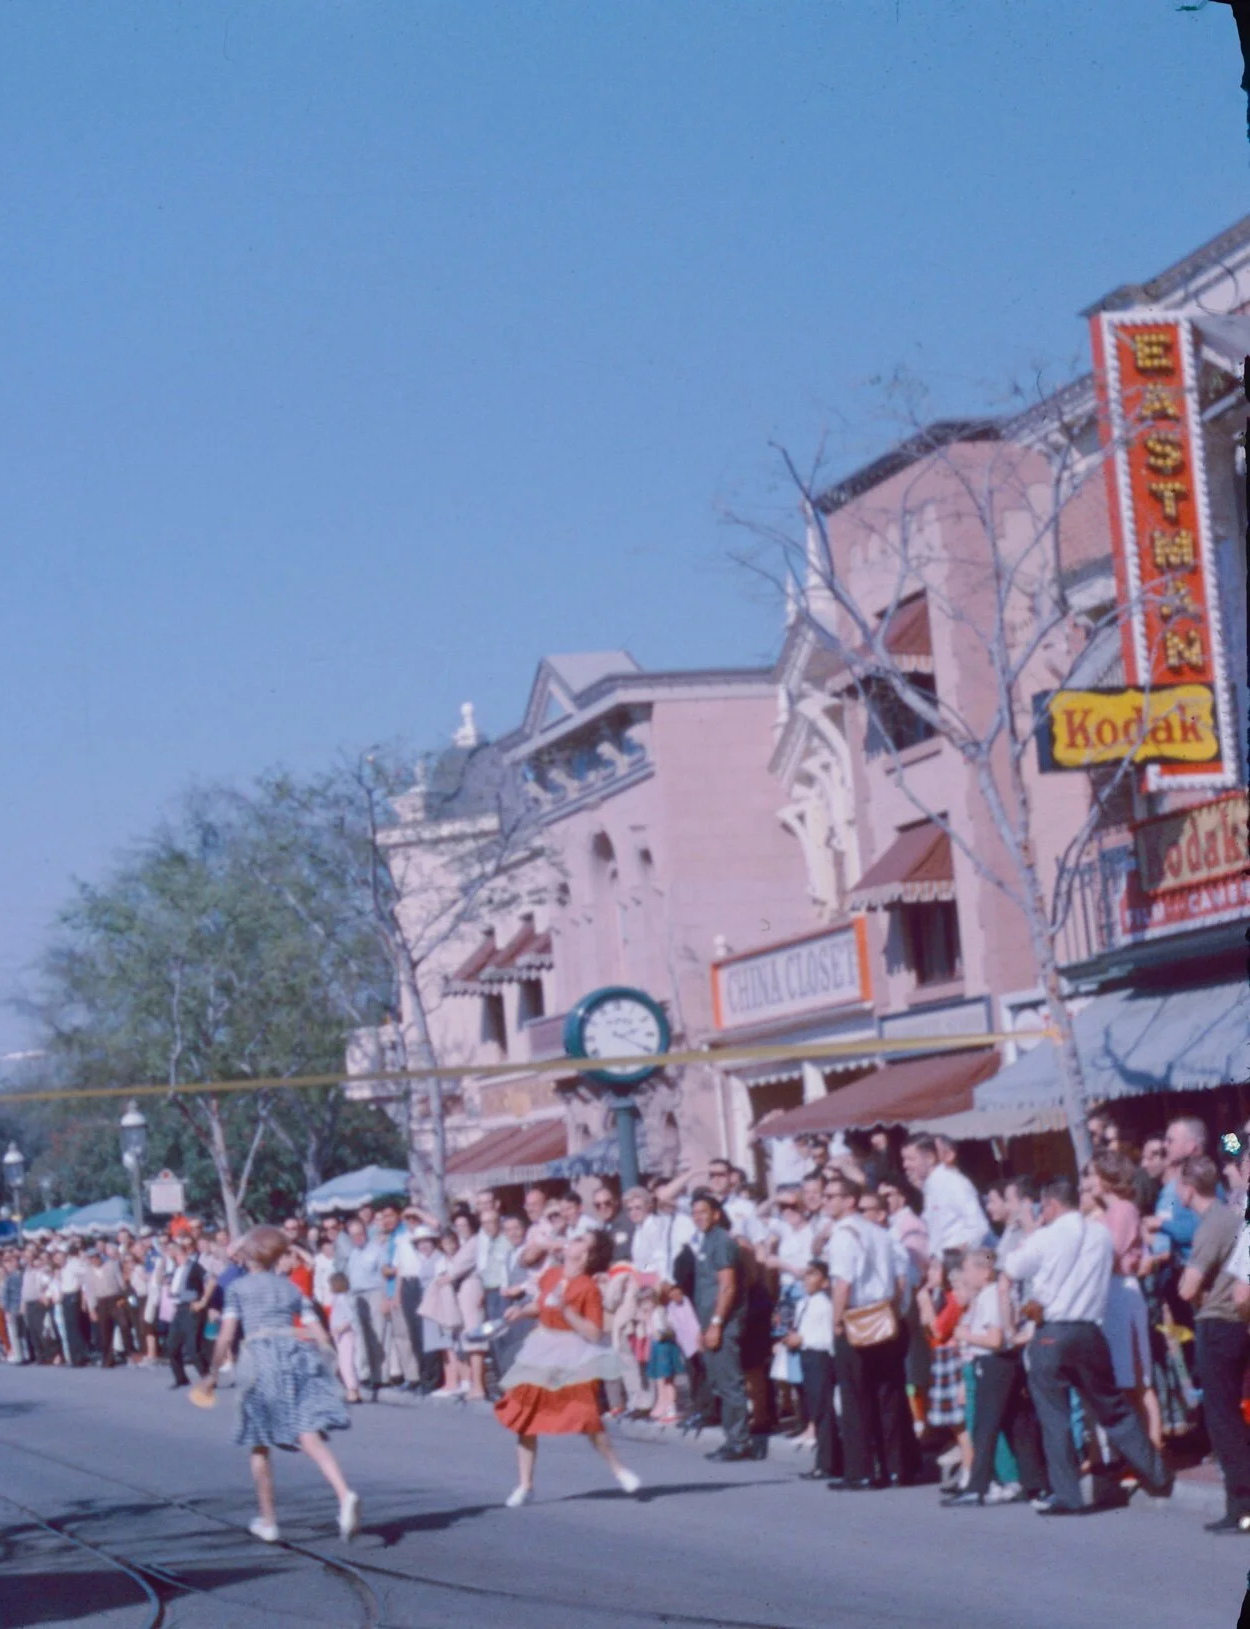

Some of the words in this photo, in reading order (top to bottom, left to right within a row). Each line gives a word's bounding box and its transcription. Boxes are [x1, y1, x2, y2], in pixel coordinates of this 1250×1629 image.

[1133, 331, 1203, 668] EASTMAN
[1063, 702, 1203, 750] Kodak
[727, 958, 784, 1014] CHINA
[785, 939, 856, 1000] CLOSET
